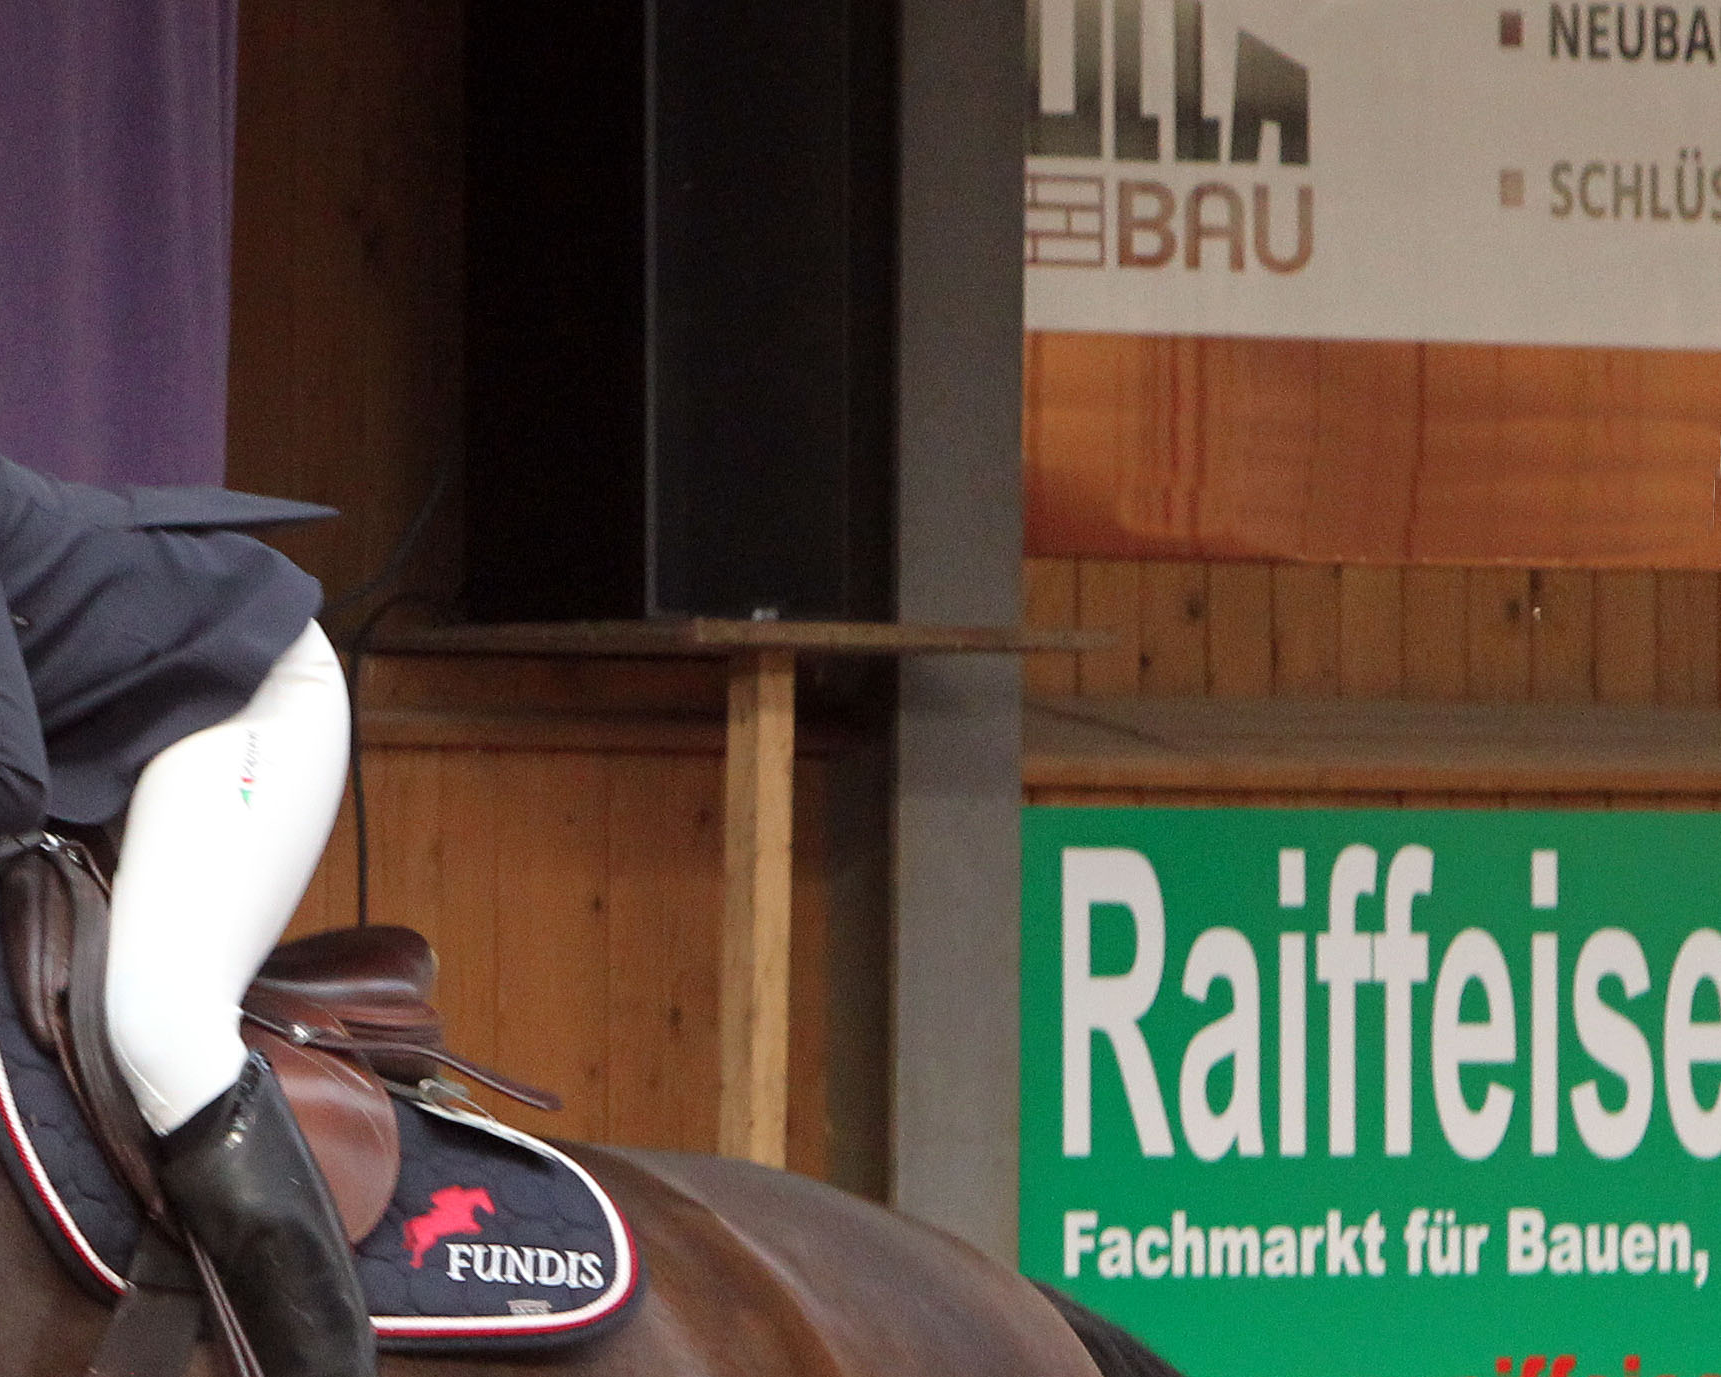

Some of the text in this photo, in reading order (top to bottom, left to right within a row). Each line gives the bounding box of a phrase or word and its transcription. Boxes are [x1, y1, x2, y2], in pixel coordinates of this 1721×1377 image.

[1550, 4, 1721, 63] NEUBA
[1118, 180, 1314, 274] BAU
[1062, 843, 1721, 1162] Raiffeise
[445, 1243, 605, 1290] FUNDIS
[1063, 1207, 1710, 1288] Fachmarkt für Bauen,
